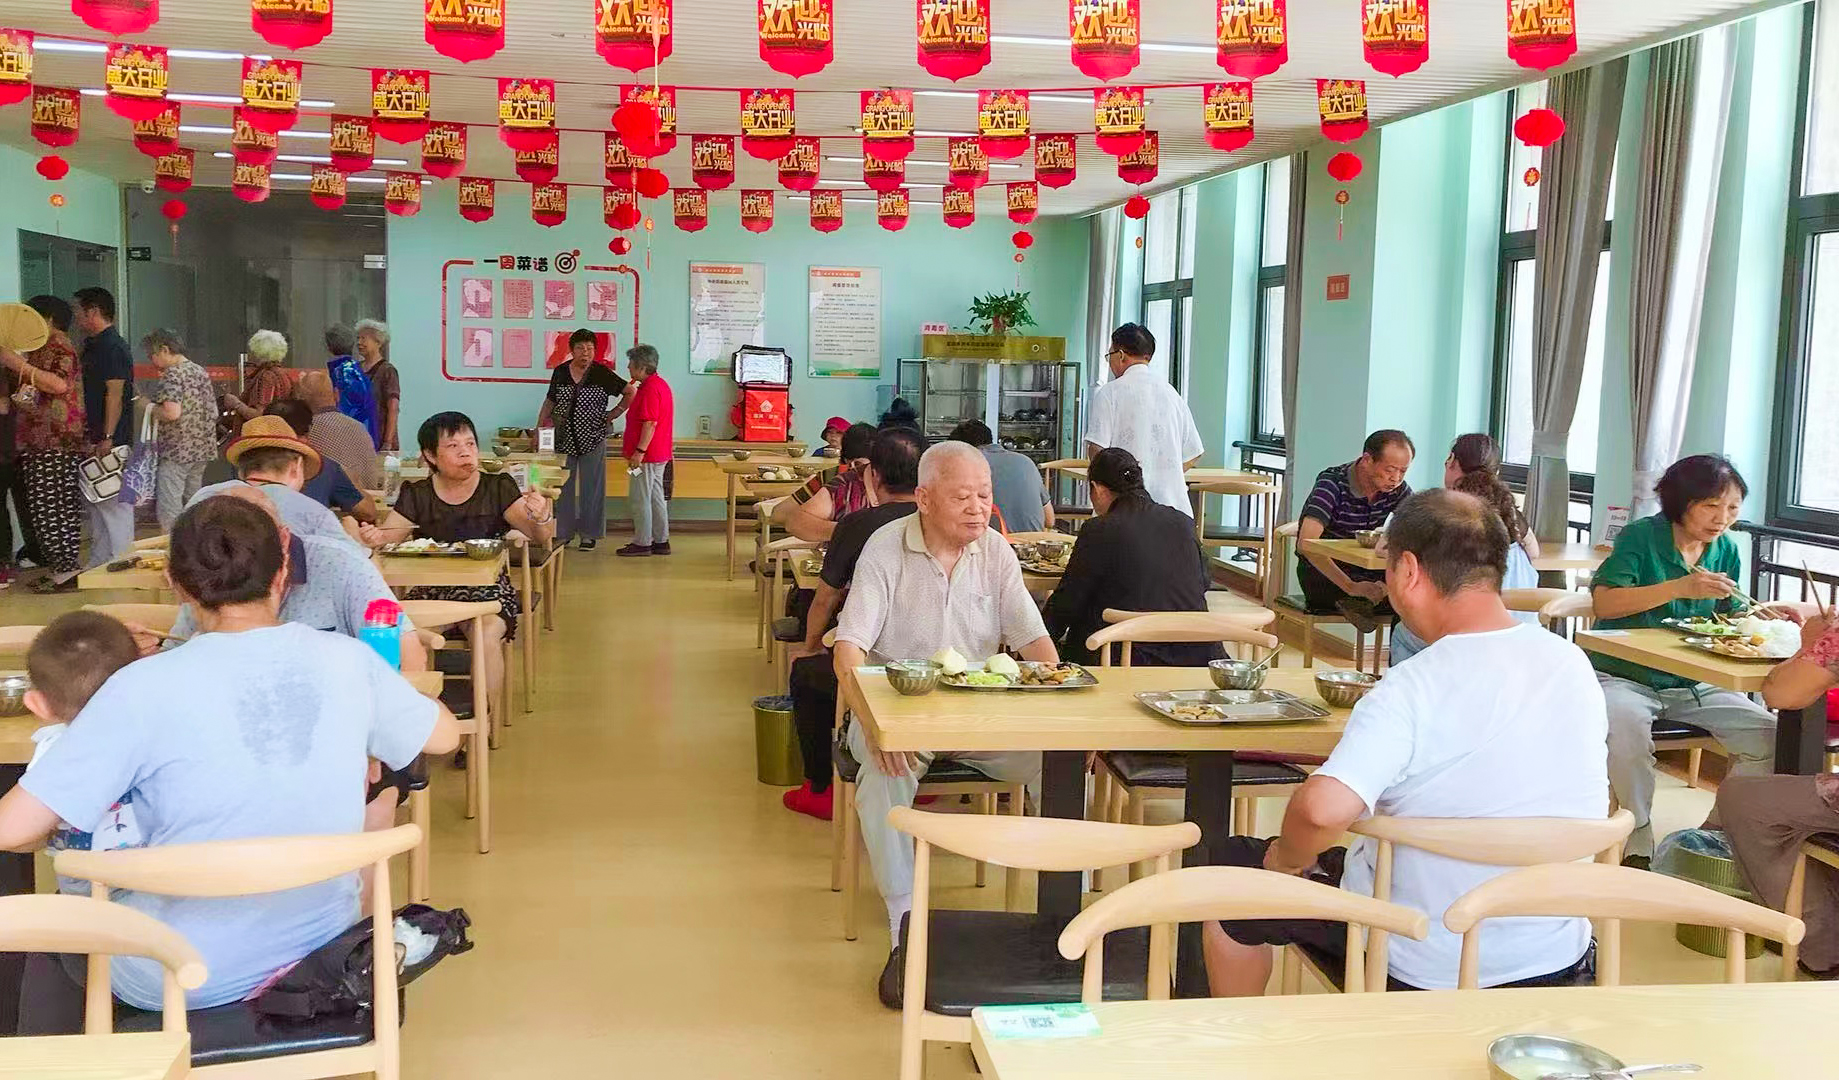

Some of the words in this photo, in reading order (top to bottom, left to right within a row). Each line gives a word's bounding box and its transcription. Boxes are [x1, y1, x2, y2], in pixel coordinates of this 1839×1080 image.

[427, 14, 465, 22] Welcome
[467, 6, 502, 27] 光临
[762, 0, 829, 32] 欢迎
[919, 0, 987, 37] 欢迎
[1073, 0, 1137, 37] 欢迎
[1220, 0, 1284, 38] 欢迎
[1365, 0, 1426, 36] 欢迎
[1510, 0, 1572, 31] 欢迎
[596, 25, 634, 33] Welcome
[797, 22, 830, 41] 光临
[955, 25, 988, 45] 光临
[1105, 26, 1137, 45] 光临
[1252, 26, 1285, 44] 光临
[1396, 23, 1426, 41] 光临
[1508, 29, 1540, 37] Welcome
[1541, 17, 1572, 35] 光临
[918, 36, 954, 45] Welcome
[1071, 36, 1104, 45] Welcome
[1217, 37, 1250, 45] Welcome
[1363, 33, 1395, 41] Welcome
[0, 51, 33, 72] 开业
[106, 65, 168, 89] 盛大开业
[243, 79, 301, 101] 盛大开业
[35, 96, 77, 121] 欢迎
[373, 91, 430, 111] 盛大开业
[500, 100, 555, 120] 盛大开业
[1319, 93, 1367, 112] 盛大开业
[742, 110, 795, 128] 盛大开业
[862, 111, 914, 130] 盛大开业
[979, 110, 1029, 129] 盛大开业
[1095, 106, 1144, 126] 盛大开业
[1205, 102, 1252, 121] 盛大开业
[333, 122, 371, 147] 欢迎
[424, 129, 464, 153] 欢迎
[694, 143, 732, 167] 欢迎
[1037, 142, 1073, 165] 欢迎
